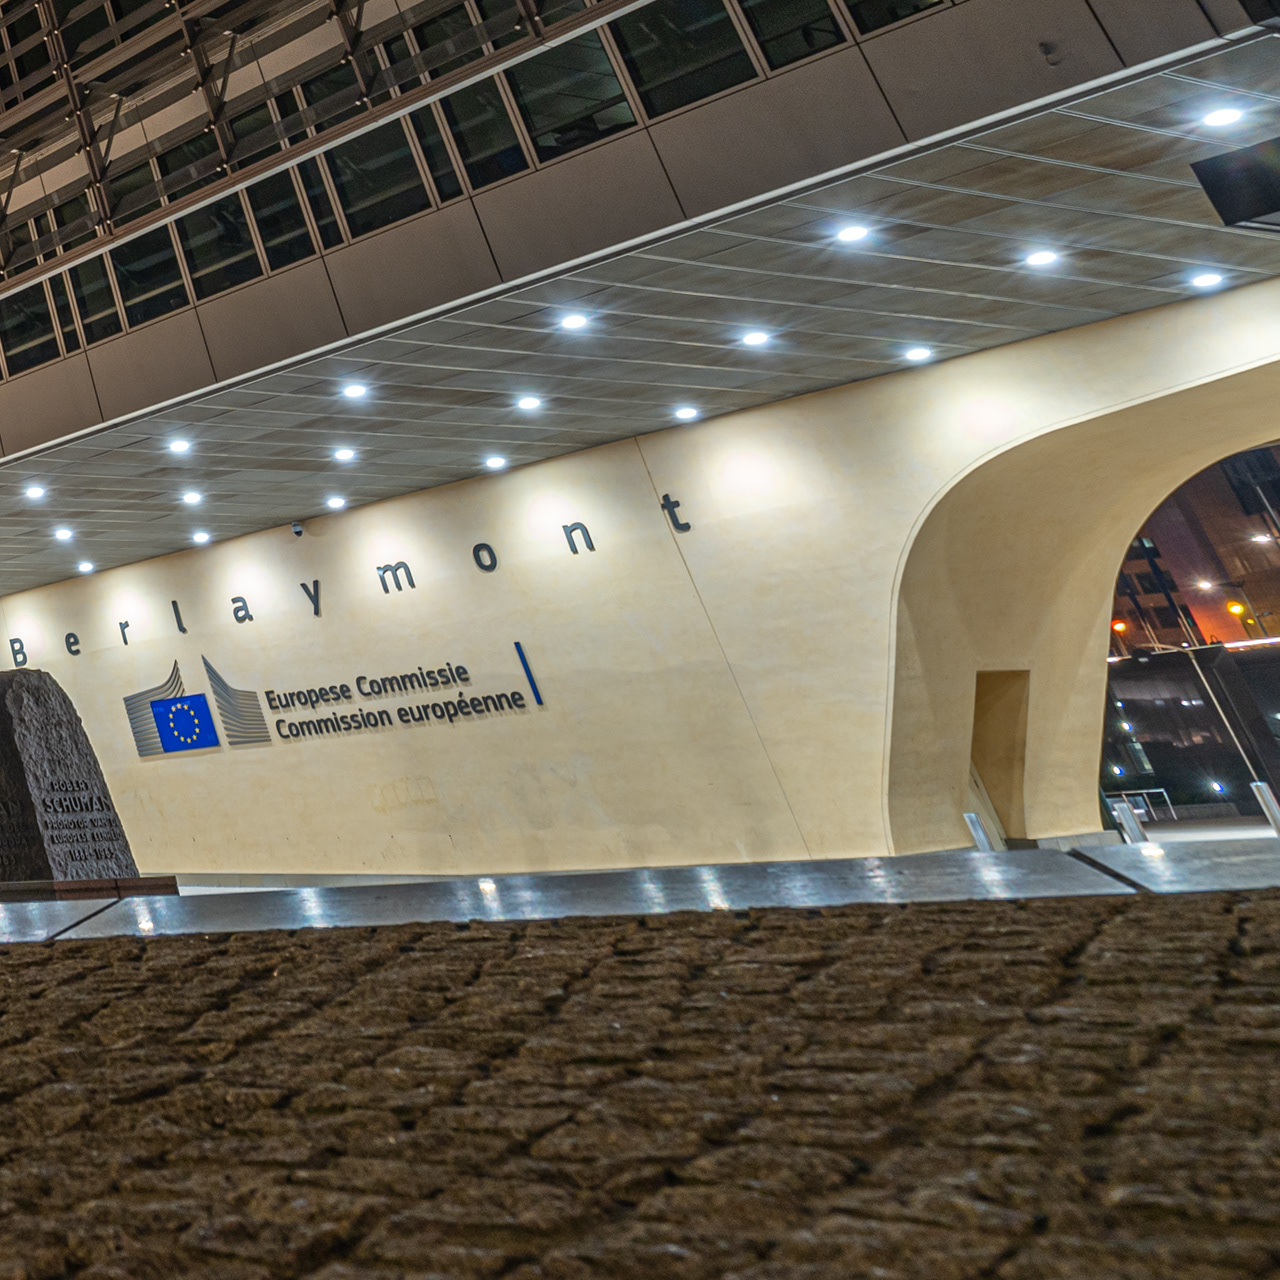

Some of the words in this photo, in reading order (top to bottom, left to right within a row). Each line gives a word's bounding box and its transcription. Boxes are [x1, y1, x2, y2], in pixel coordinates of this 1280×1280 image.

[9, 493, 691, 668] Berlaymont
[264, 683, 352, 710] Europese
[355, 662, 470, 697] Commissie
[275, 708, 393, 740] Commission
[397, 690, 526, 724] européenne
[43, 796, 112, 813] SCHUMAN
[51, 780, 90, 792] ROBERT
